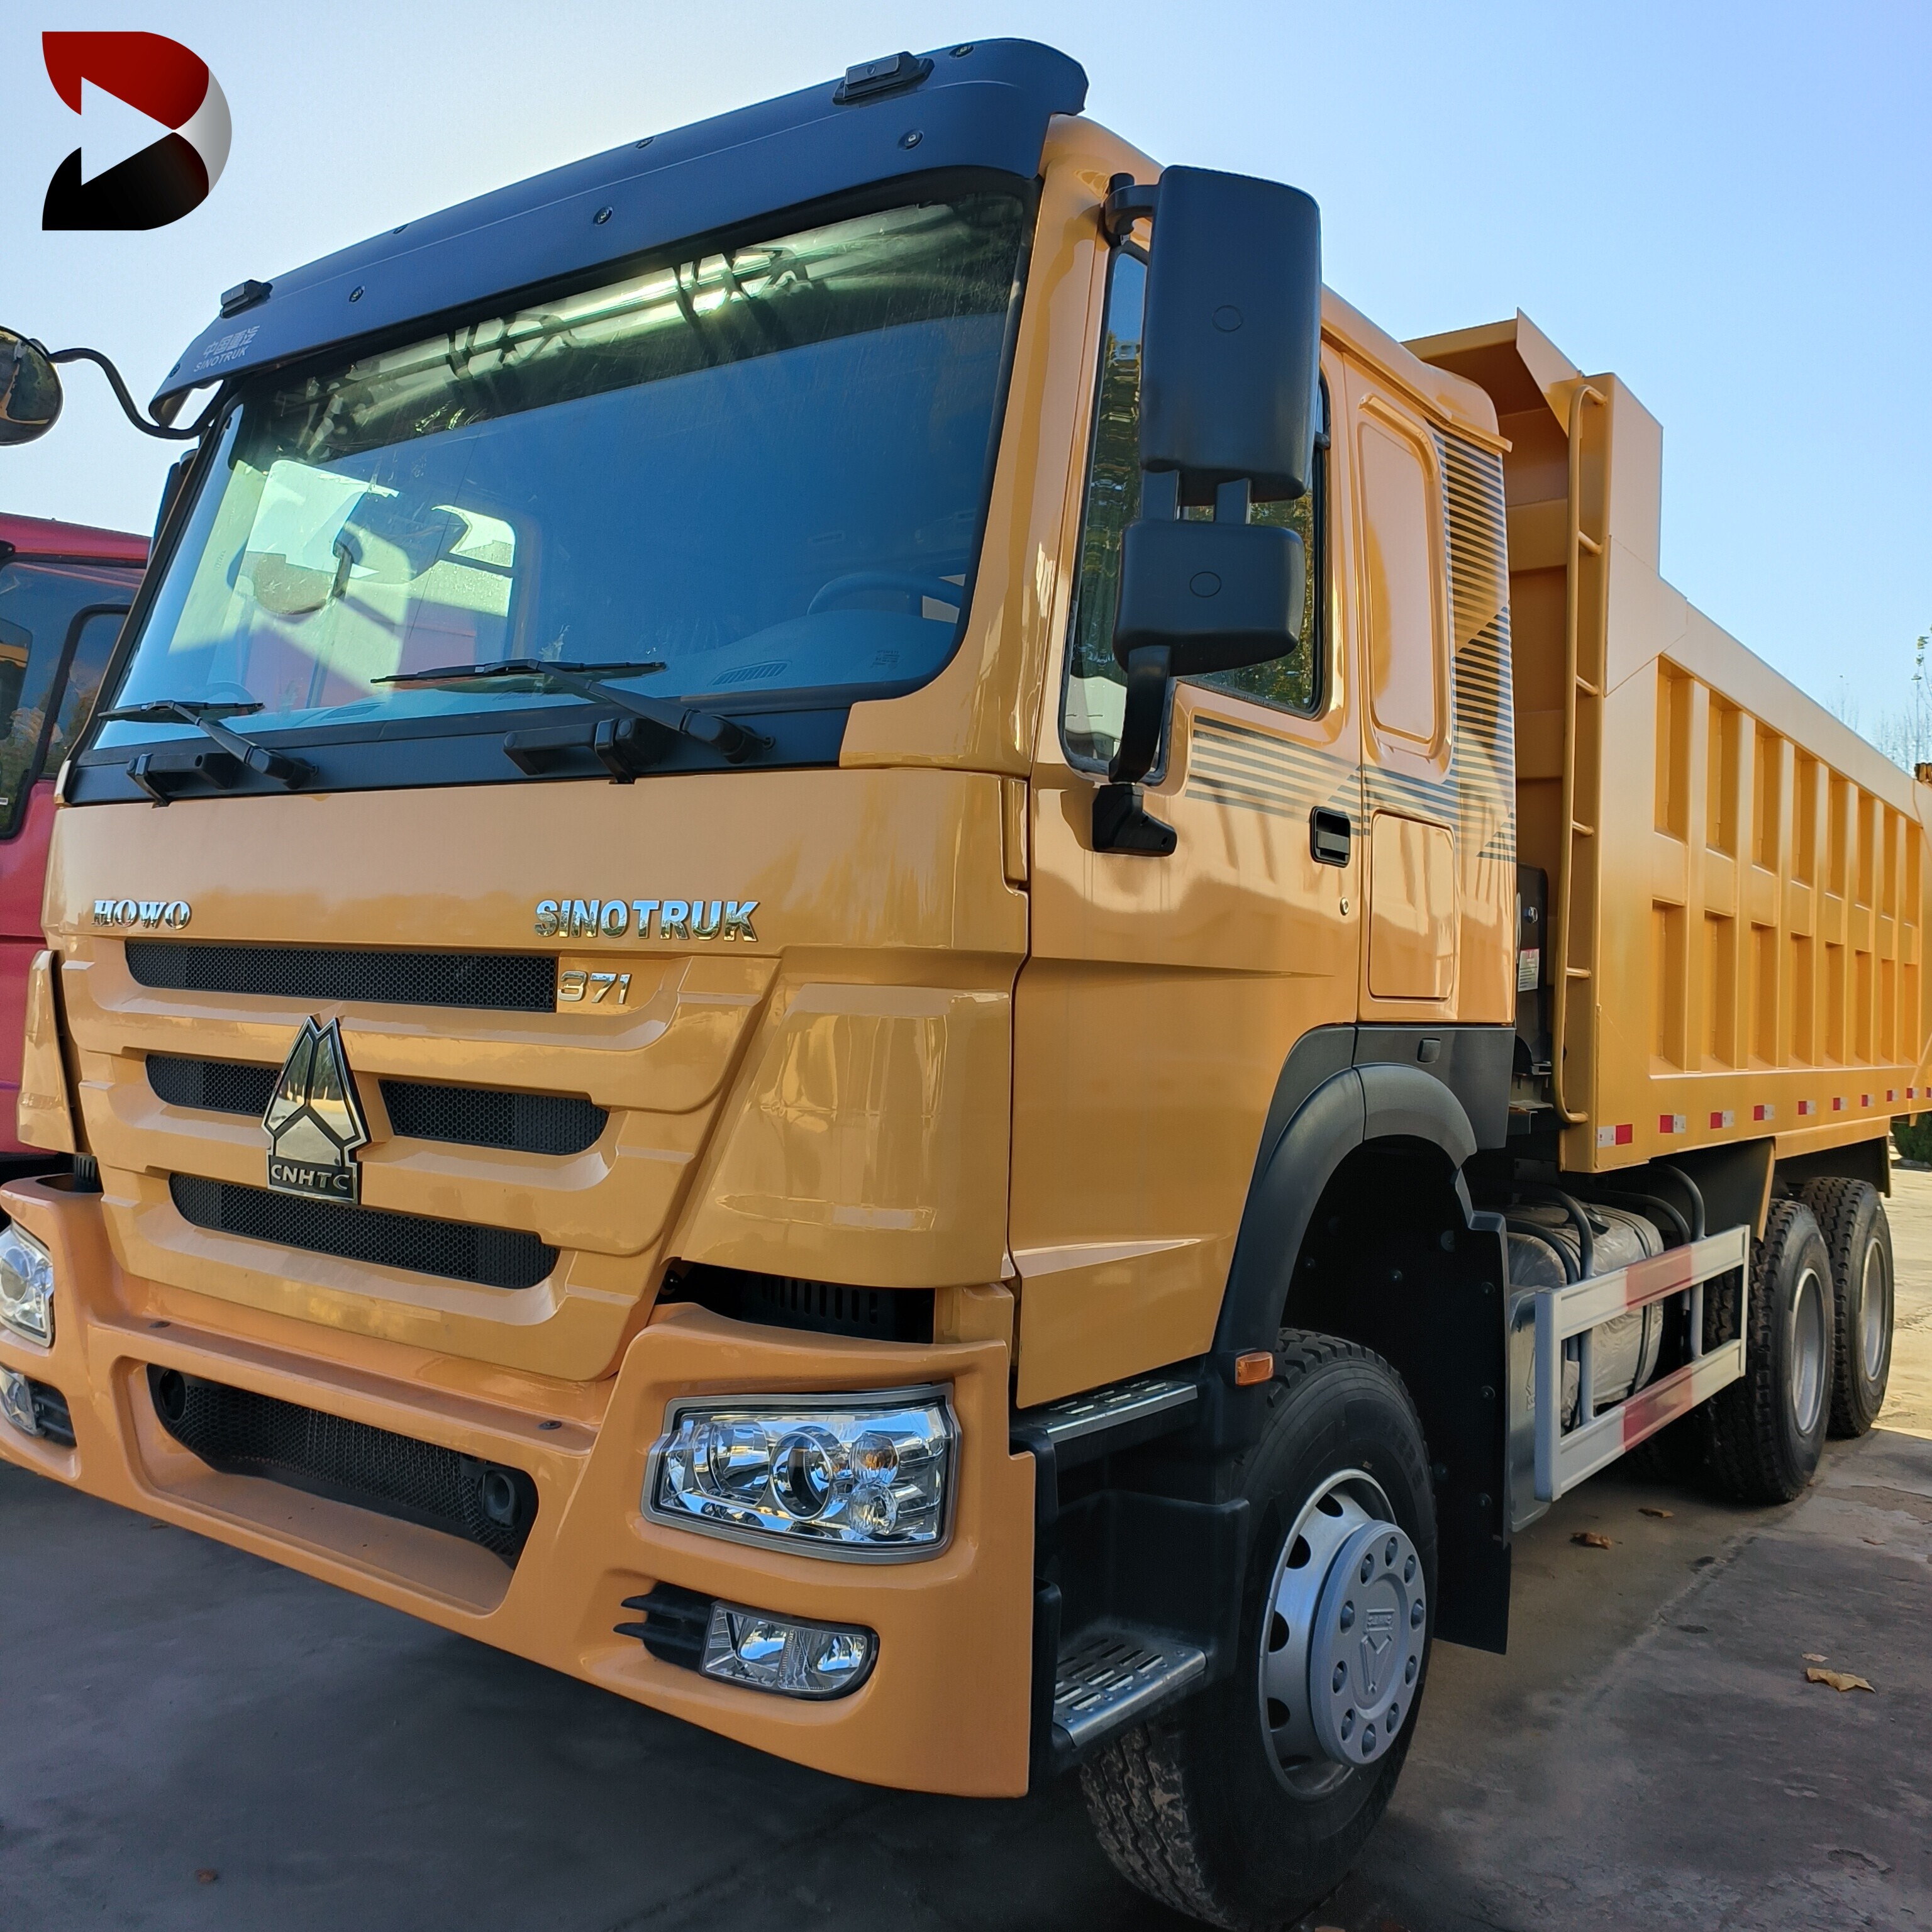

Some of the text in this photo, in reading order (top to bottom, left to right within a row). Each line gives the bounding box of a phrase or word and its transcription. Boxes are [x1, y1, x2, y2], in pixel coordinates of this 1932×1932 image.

[193, 345, 250, 372] SINOTRUK
[91, 899, 191, 930] HOWO
[534, 899, 760, 942] SINOTRUK
[558, 970, 631, 1004] 371
[270, 1163, 350, 1191] CNHTC
